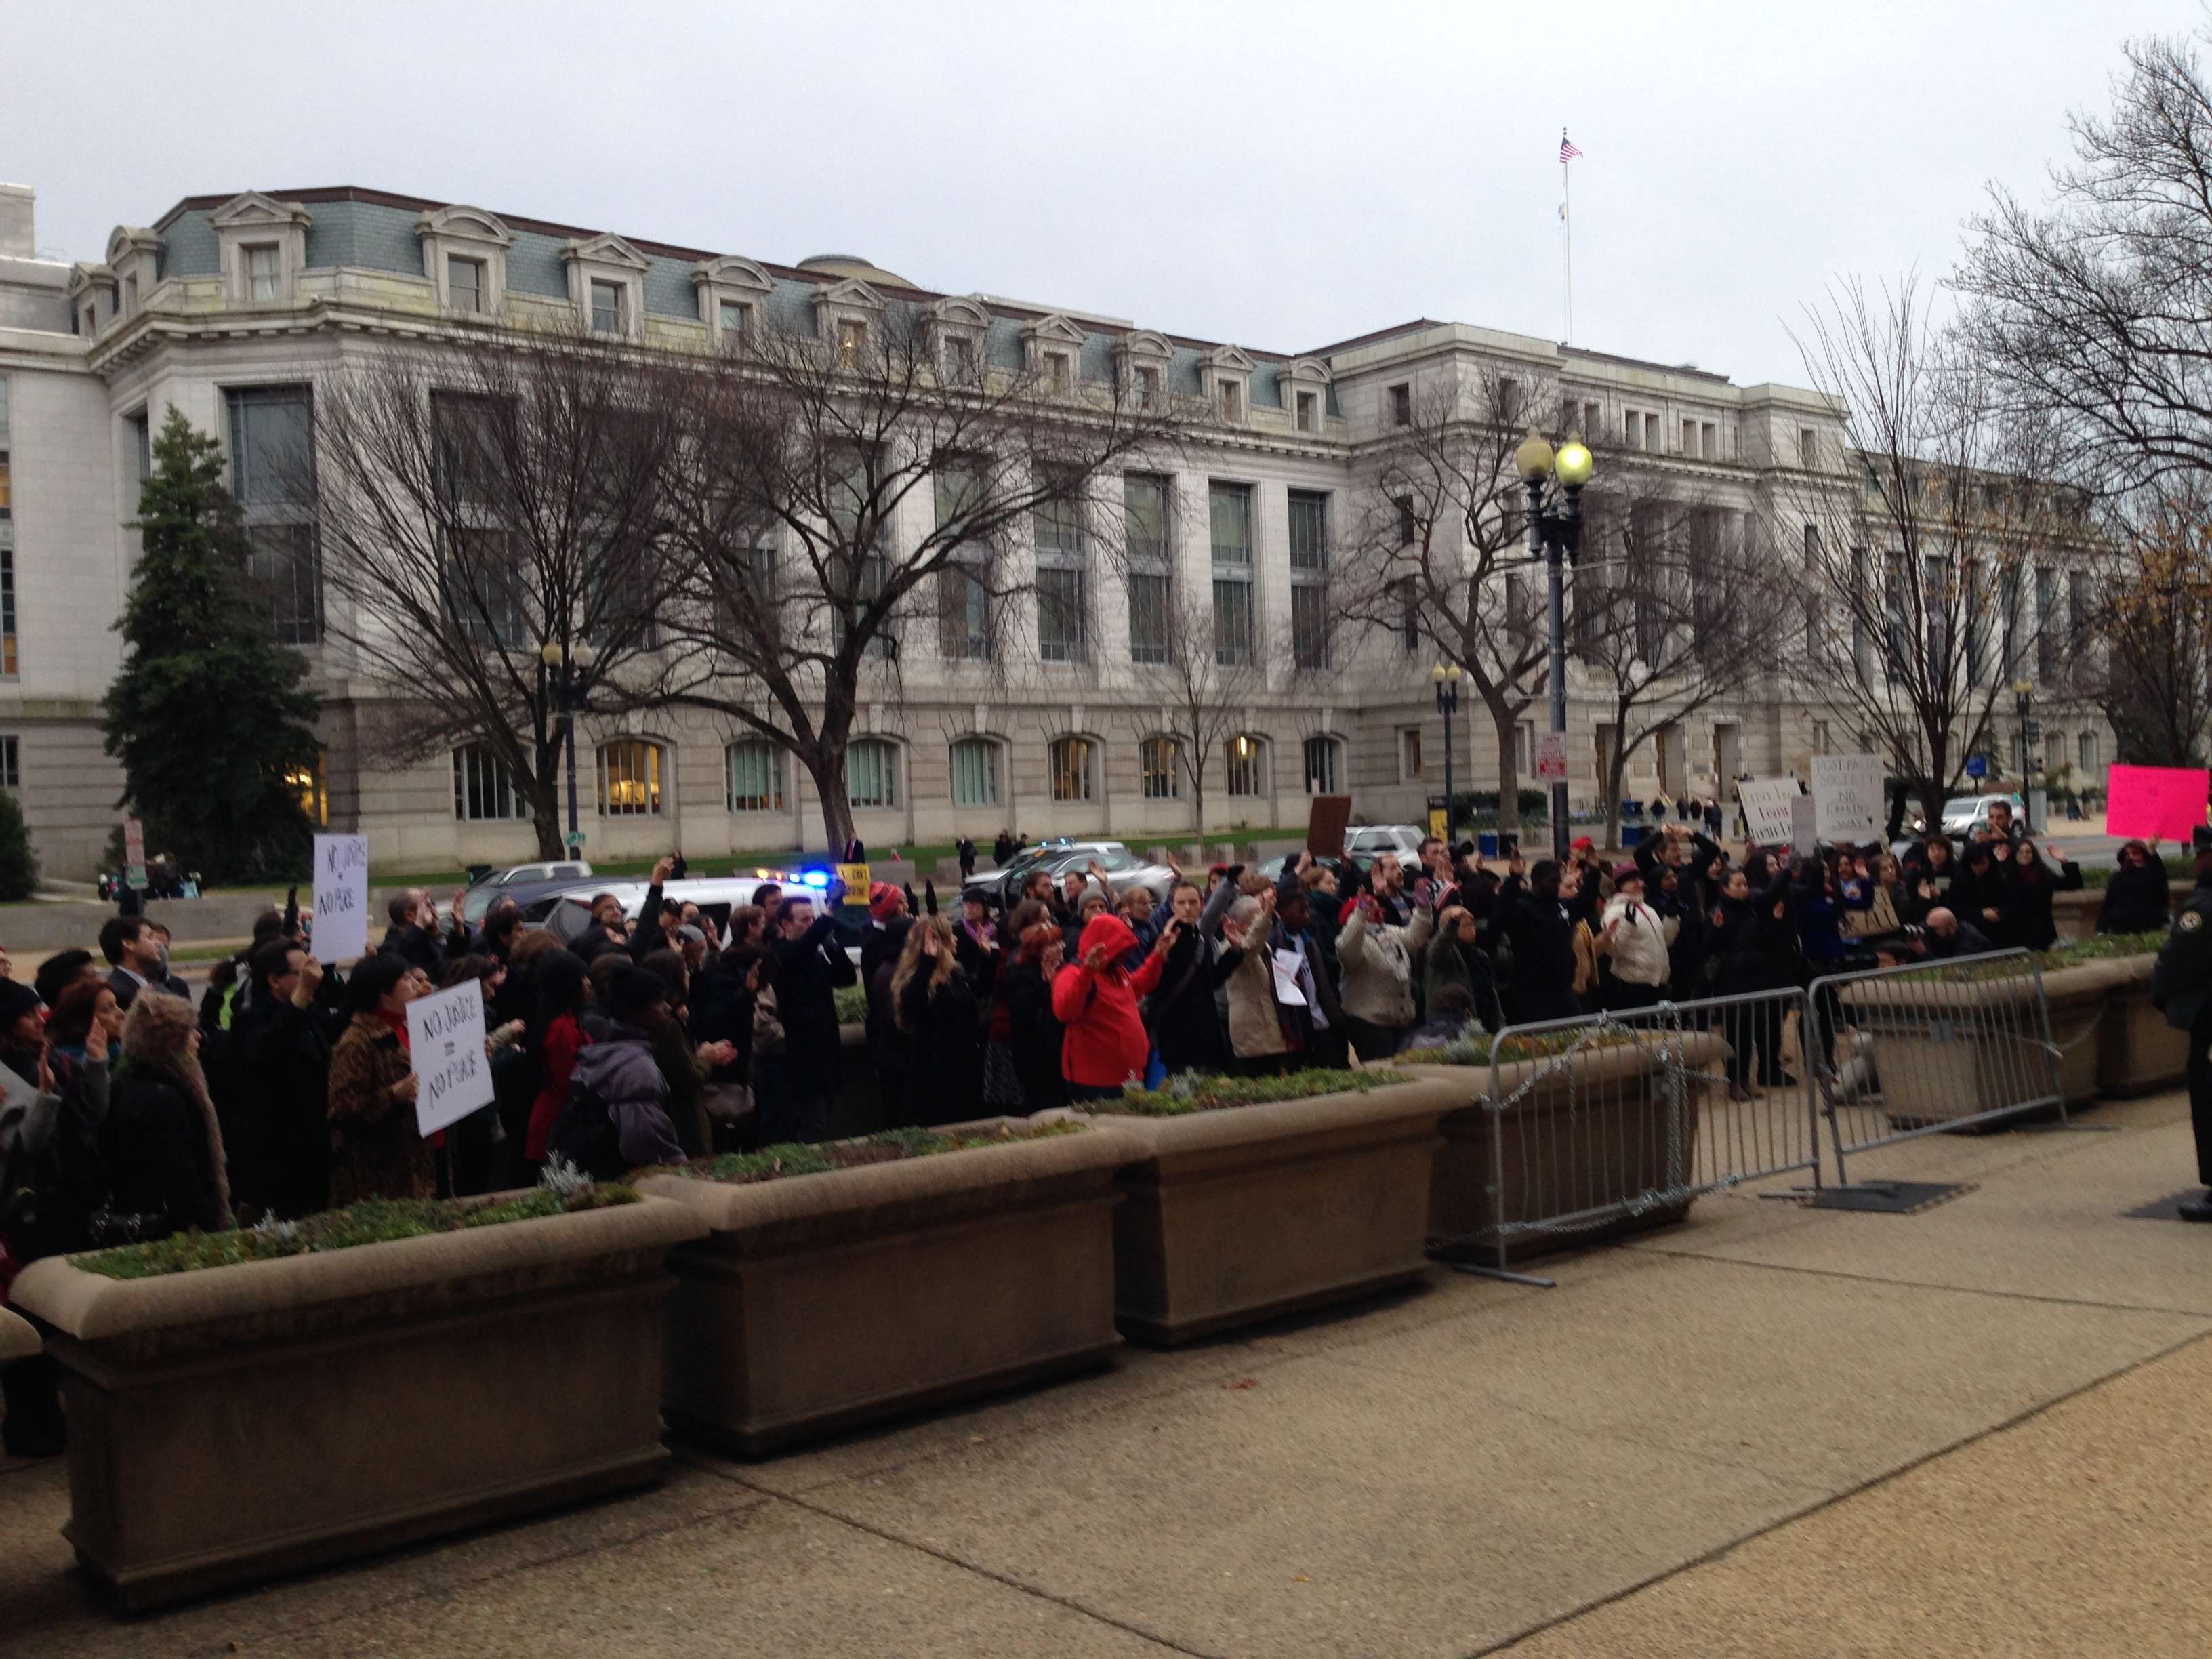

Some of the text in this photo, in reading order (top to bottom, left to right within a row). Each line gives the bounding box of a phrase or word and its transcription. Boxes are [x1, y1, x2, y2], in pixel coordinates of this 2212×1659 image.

[1839, 791, 1855, 802] NO
[319, 891, 333, 916] NO
[422, 994, 477, 1043] NO JUSTICE
[428, 1050, 478, 1109] NO PEACE
